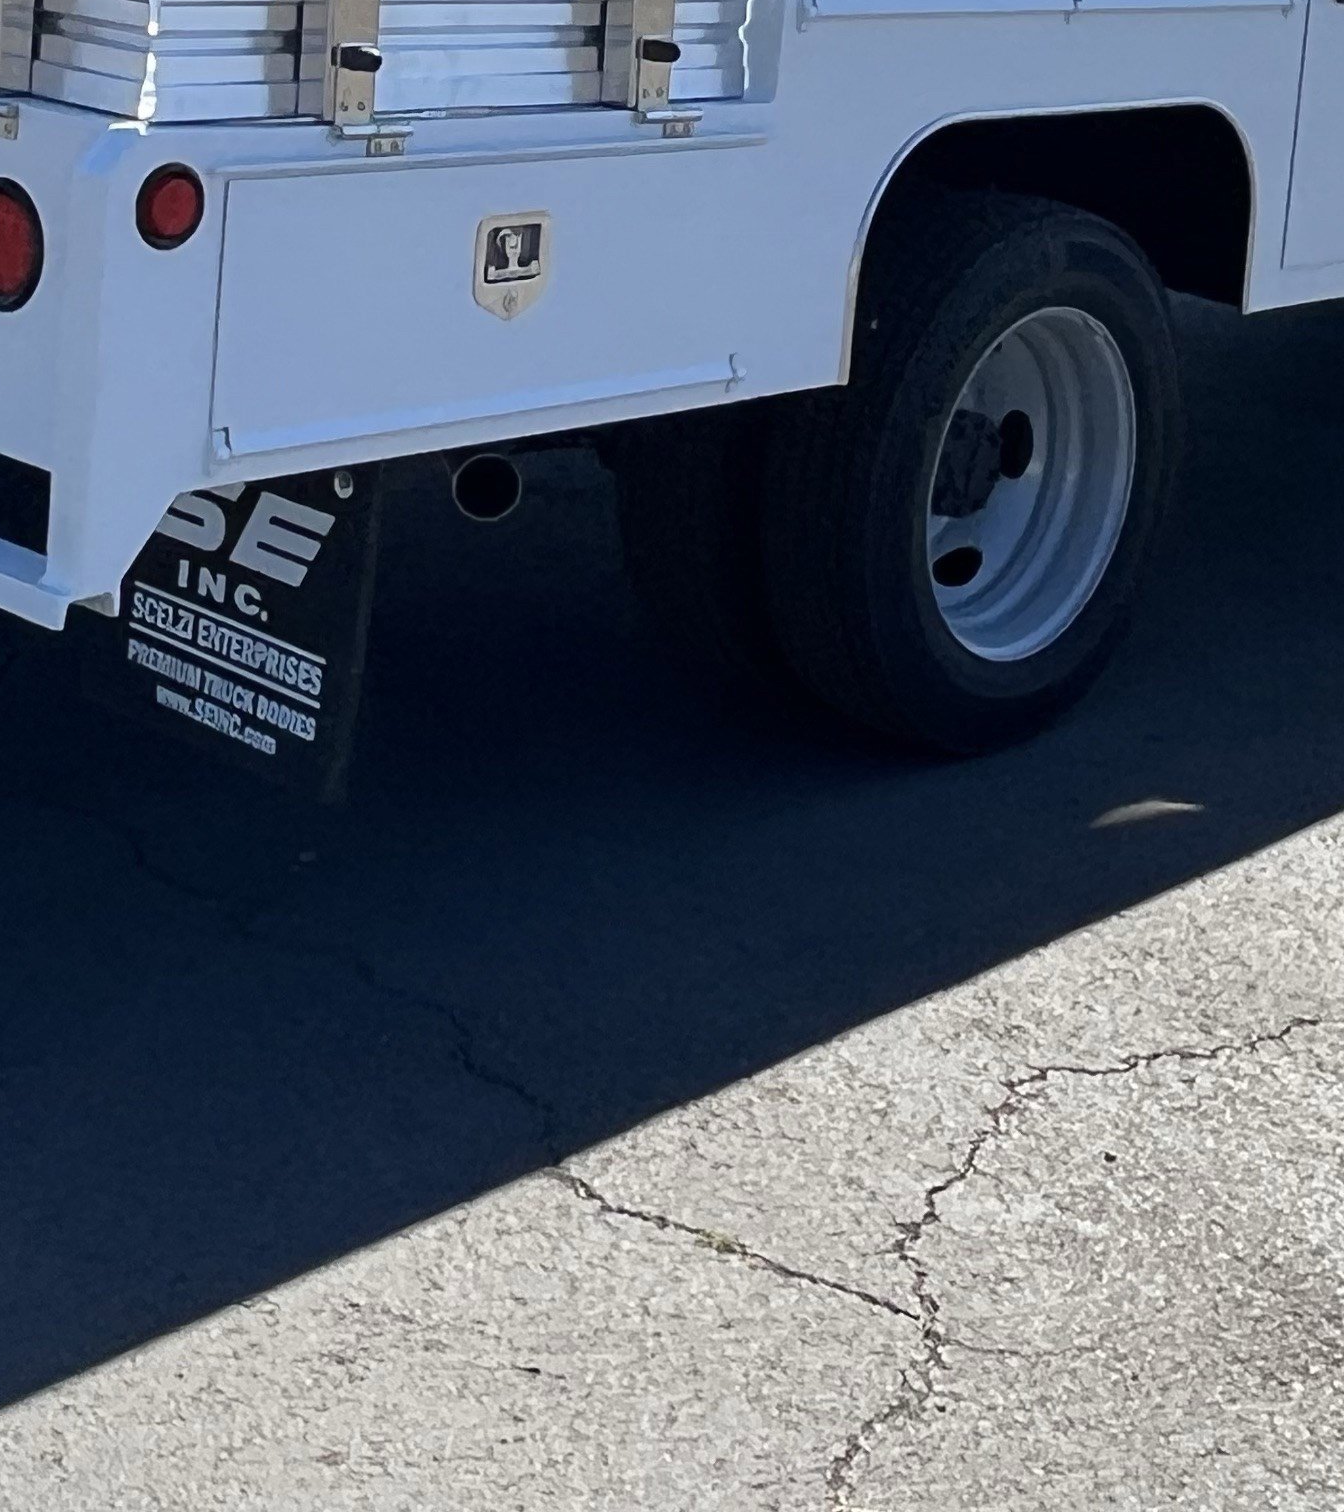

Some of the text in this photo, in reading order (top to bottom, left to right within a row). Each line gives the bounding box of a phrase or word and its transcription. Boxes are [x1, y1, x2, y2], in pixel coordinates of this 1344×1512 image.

[156, 482, 336, 587] SE
[177, 559, 269, 622] INC.
[127, 638, 316, 741] PREMIUM TRUCK BODIES
[197, 617, 323, 696] ENTERPRISES
